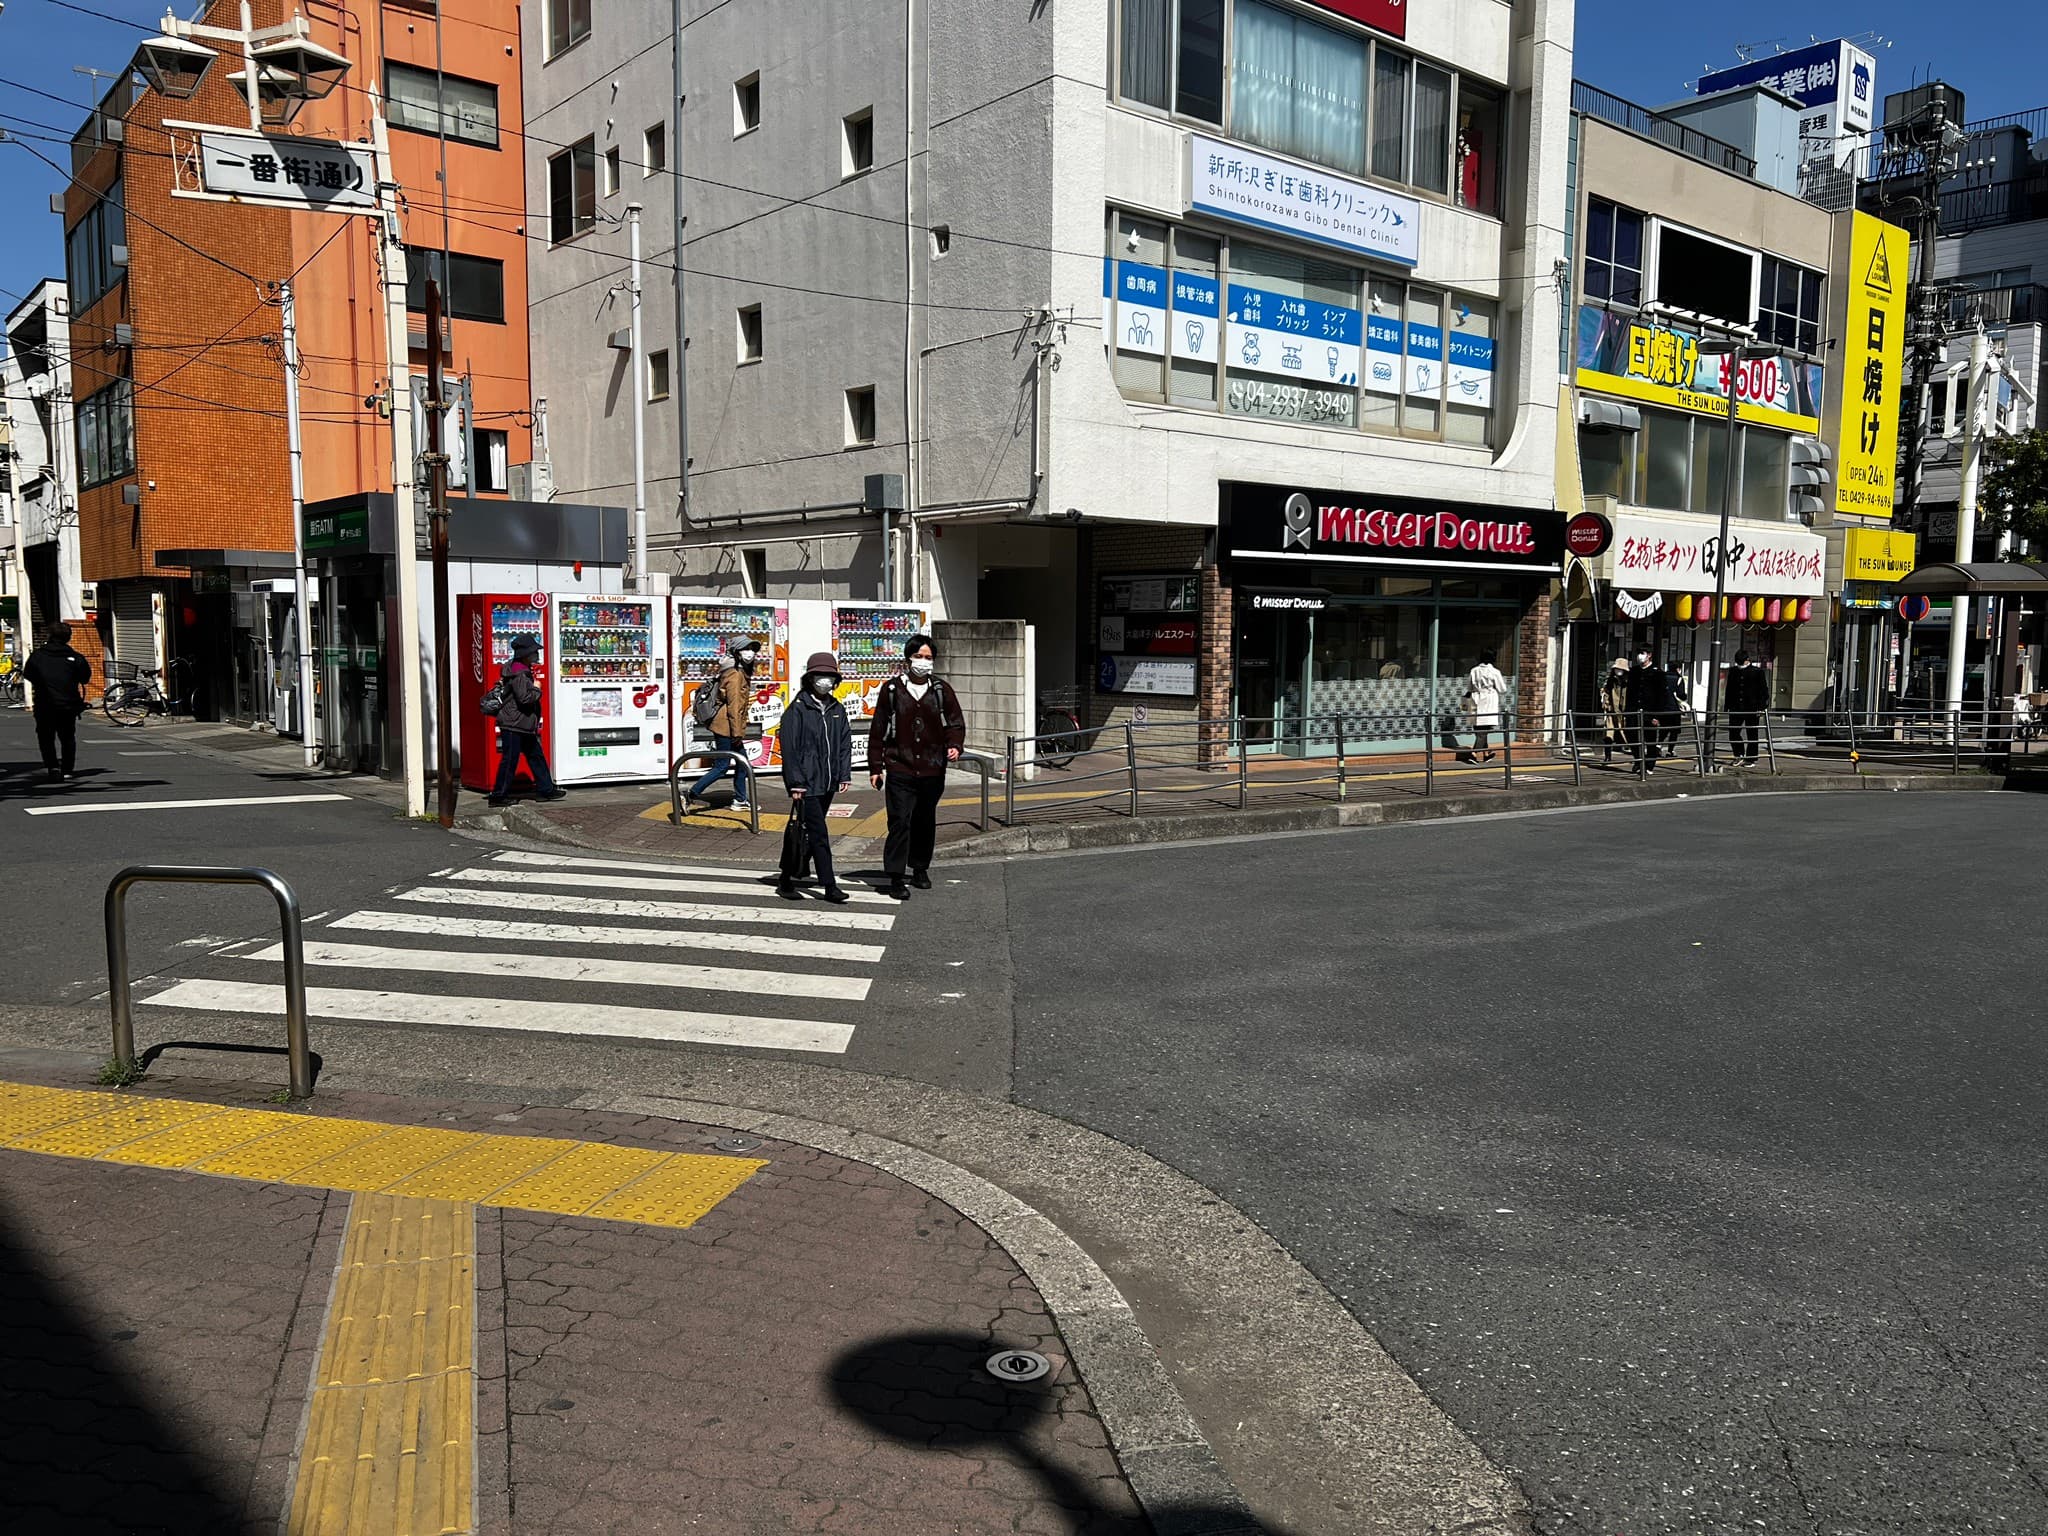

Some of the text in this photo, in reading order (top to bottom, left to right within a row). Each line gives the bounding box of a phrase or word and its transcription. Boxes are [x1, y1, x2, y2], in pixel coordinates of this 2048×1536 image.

[216, 154, 363, 190] 一番街通り
[1208, 153, 1390, 224] 新所沢ぎぼ歯科クリニック
[1208, 184, 1399, 246] Shintokorozawa Gibo Dental Clinic
[1126, 275, 1157, 294] 歯周病
[1176, 284, 1215, 305] 根管治療
[1243, 292, 1261, 308] 小児
[1243, 307, 1261, 323] 歯科
[1280, 299, 1306, 317] 入れ歯
[1322, 309, 1347, 324] インプ
[1276, 315, 1309, 331] ブリッジ
[1322, 324, 1344, 338] ラント
[1368, 325, 1399, 343] 矯正歯科
[1410, 333, 1439, 349] 審美歯科
[1449, 342, 1492, 360] ホワイトニング
[1628, 324, 1699, 388] 日焼け
[1860, 307, 1885, 456] 日焼け
[1246, 380, 1349, 414] 04-2937-3940
[1678, 392, 1740, 415] THE SUN LOUNE
[1839, 488, 1848, 502] TEL
[1435, 511, 1536, 554] Donut
[1619, 536, 1697, 572] 名物串カツ
[1744, 548, 1822, 581] 大阪伝統の味
[1859, 558, 1911, 572] THE SUN LOUNGE
